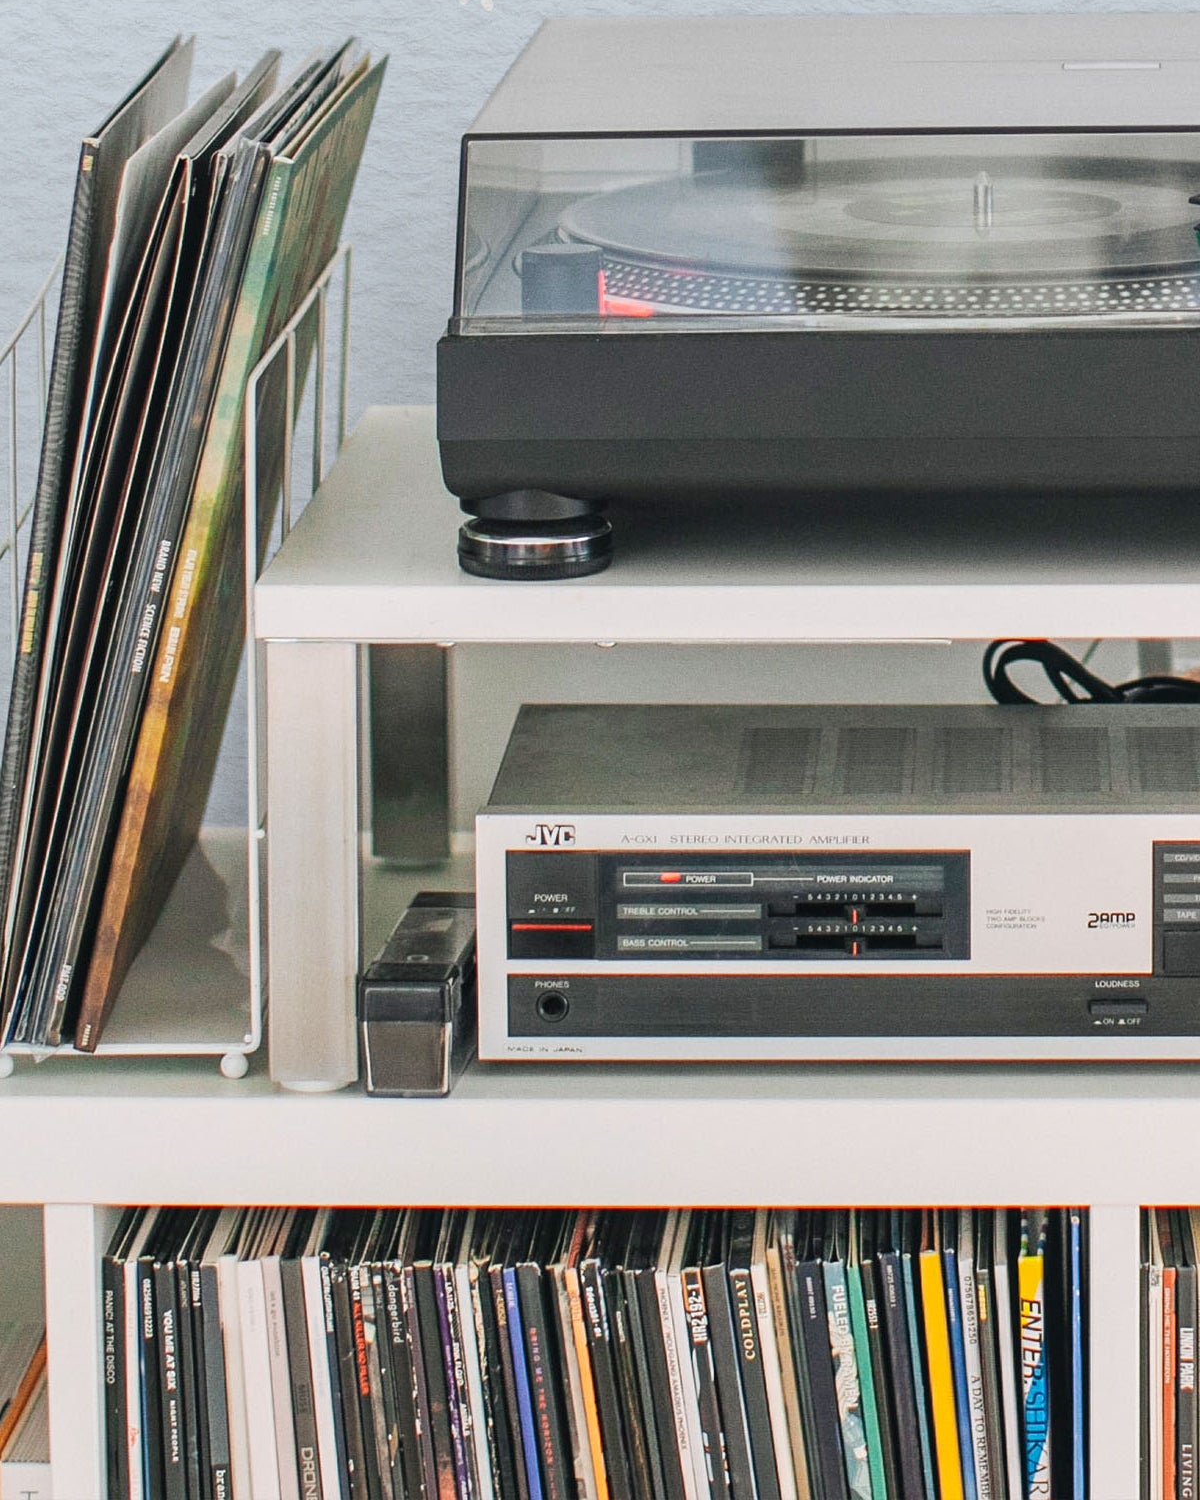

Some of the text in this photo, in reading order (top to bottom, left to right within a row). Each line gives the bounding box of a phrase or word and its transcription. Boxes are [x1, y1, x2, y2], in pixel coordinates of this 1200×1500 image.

[131, 540, 171, 673] BRAND NEW SCIENCE FICTION
[526, 824, 576, 846] JVC
[670, 835, 718, 844] STEREO
[724, 835, 803, 844] INTEGRATED
[809, 835, 871, 844] AMPLIFIER
[686, 875, 717, 884] POWER
[816, 875, 894, 883] POWER INDICATOR
[533, 893, 568, 903] POWER
[623, 907, 698, 916] TREBLE CONTROL
[1176, 911, 1196, 919] TAPE
[623, 939, 688, 948] BASS CONTROL
[534, 980, 570, 989] PHONES
[1095, 980, 1140, 988] LOUDNESS
[1103, 1017, 1141, 1026] ON OFF
[353, 1302, 362, 1319] ALL
[388, 1283, 404, 1344] dangerbird
[686, 1284, 708, 1344] HR2192-1
[735, 1280, 756, 1362] COLDPLAY
[1164, 1314, 1171, 1328] ME
[105, 1290, 116, 1384] PANIC! AT THE DISCO
[355, 1320, 366, 1351] KILLER
[1020, 1298, 1044, 1387] ENTER:
[831, 1285, 846, 1333] FUELED
[840, 1358, 858, 1409] RAMEN
[660, 1288, 687, 1450] PHOENIX WOLFGANG AMADEUS PHOENIX
[163, 1310, 179, 1463] YOU ME AT SIX NIGHT PEOPLE
[360, 1365, 370, 1396] FILLER
[971, 1375, 981, 1386] A
[529, 1327, 553, 1466] BRING ME THE HORIZON
[972, 1388, 984, 1413] DAY
[1179, 1327, 1194, 1498] LINKIN PARK LIVING
[975, 1416, 986, 1433] TO
